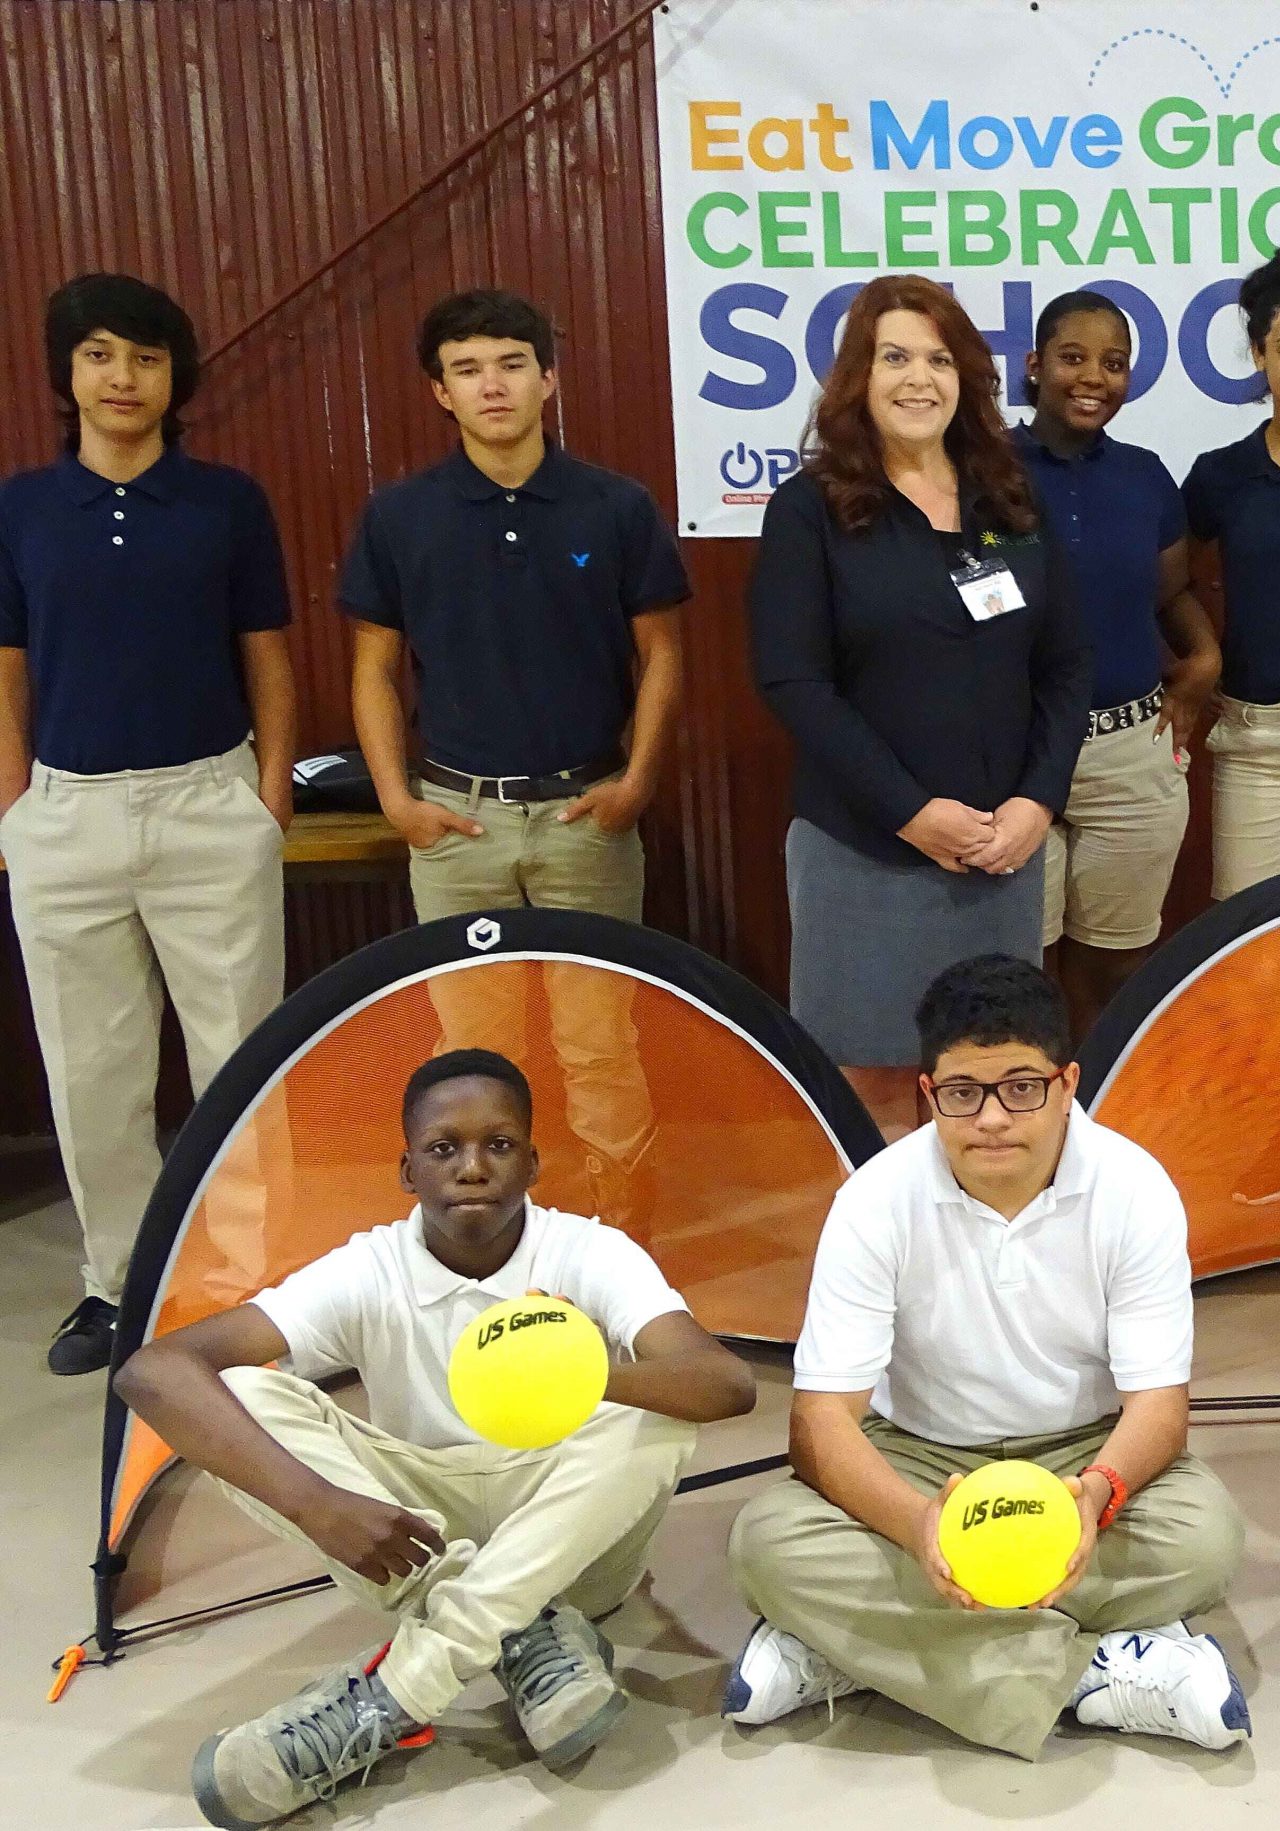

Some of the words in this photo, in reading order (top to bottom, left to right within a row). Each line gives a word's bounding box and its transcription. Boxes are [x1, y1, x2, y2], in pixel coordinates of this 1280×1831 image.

[688, 100, 853, 173] Eat
[869, 99, 1123, 171] Move
[477, 1317, 505, 1350] US
[509, 1310, 568, 1332] Games
[962, 1499, 990, 1531] US
[991, 1496, 1046, 1520] Games
